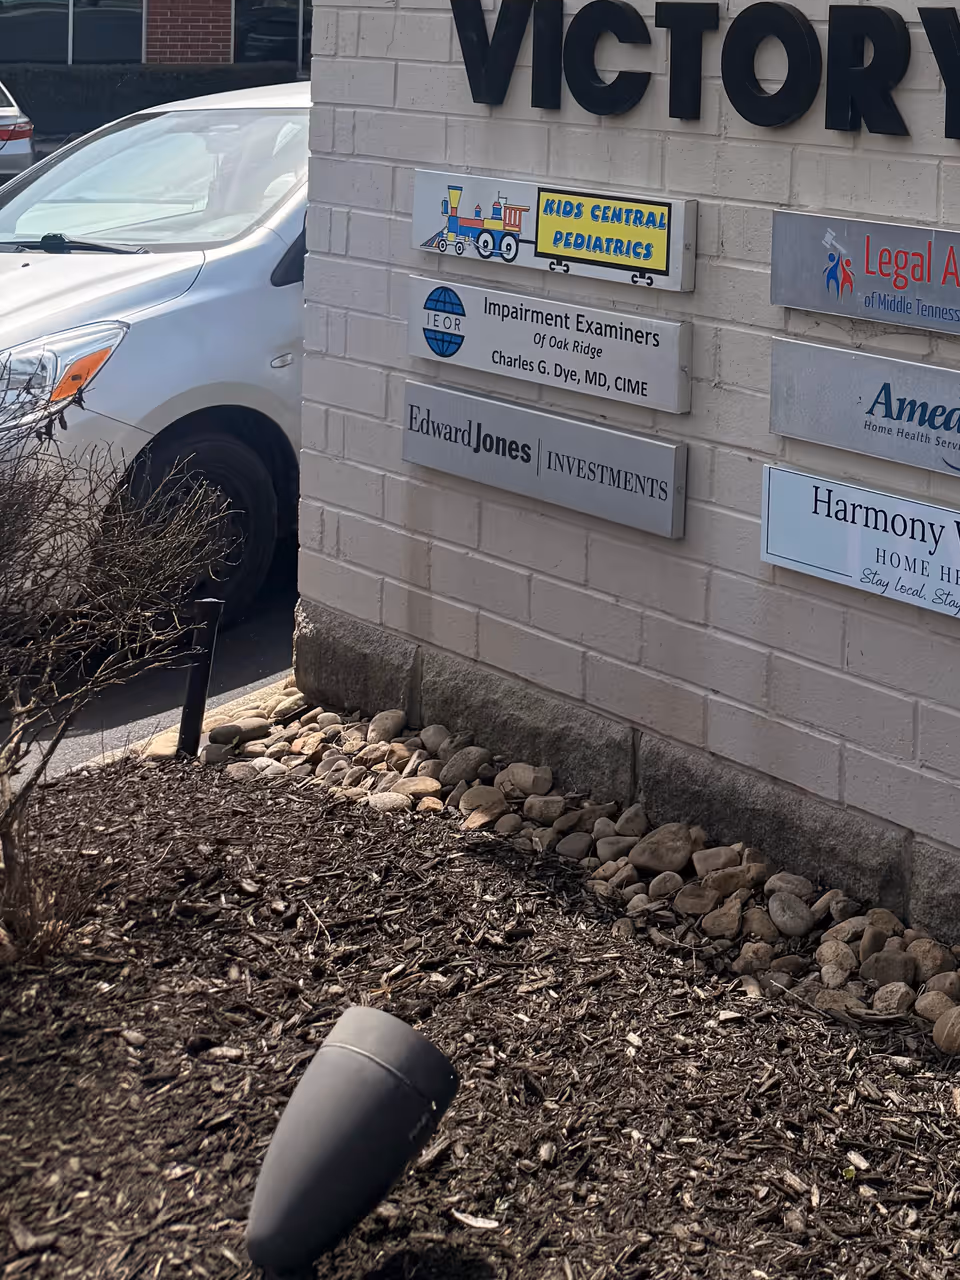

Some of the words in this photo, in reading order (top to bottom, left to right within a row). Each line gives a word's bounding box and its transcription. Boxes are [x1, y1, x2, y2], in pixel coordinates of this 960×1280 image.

[542, 198, 584, 219] KIDS
[590, 204, 667, 230] CENTRAL
[552, 231, 654, 260] PEDIATRICS
[864, 234, 932, 290] Legal
[864, 291, 877, 308] of
[878, 293, 912, 316] Middle
[426, 312, 462, 332] IEOR
[483, 297, 570, 330] Impairment
[576, 314, 660, 347] Examiners
[533, 332, 548, 348] Of
[549, 335, 569, 351] Oak
[572, 339, 603, 358] Ridge
[491, 350, 534, 373] Charles
[537, 360, 550, 375] G.
[554, 363, 581, 385] Dye,
[584, 369, 611, 391] MD,
[614, 376, 648, 397] CIME
[863, 420, 893, 436] Home
[896, 428, 931, 444] Health
[547, 450, 668, 502] INVESTMENTS
[812, 485, 946, 556] Harmony
[875, 547, 930, 578] HOME
[859, 568, 889, 594] Stay
